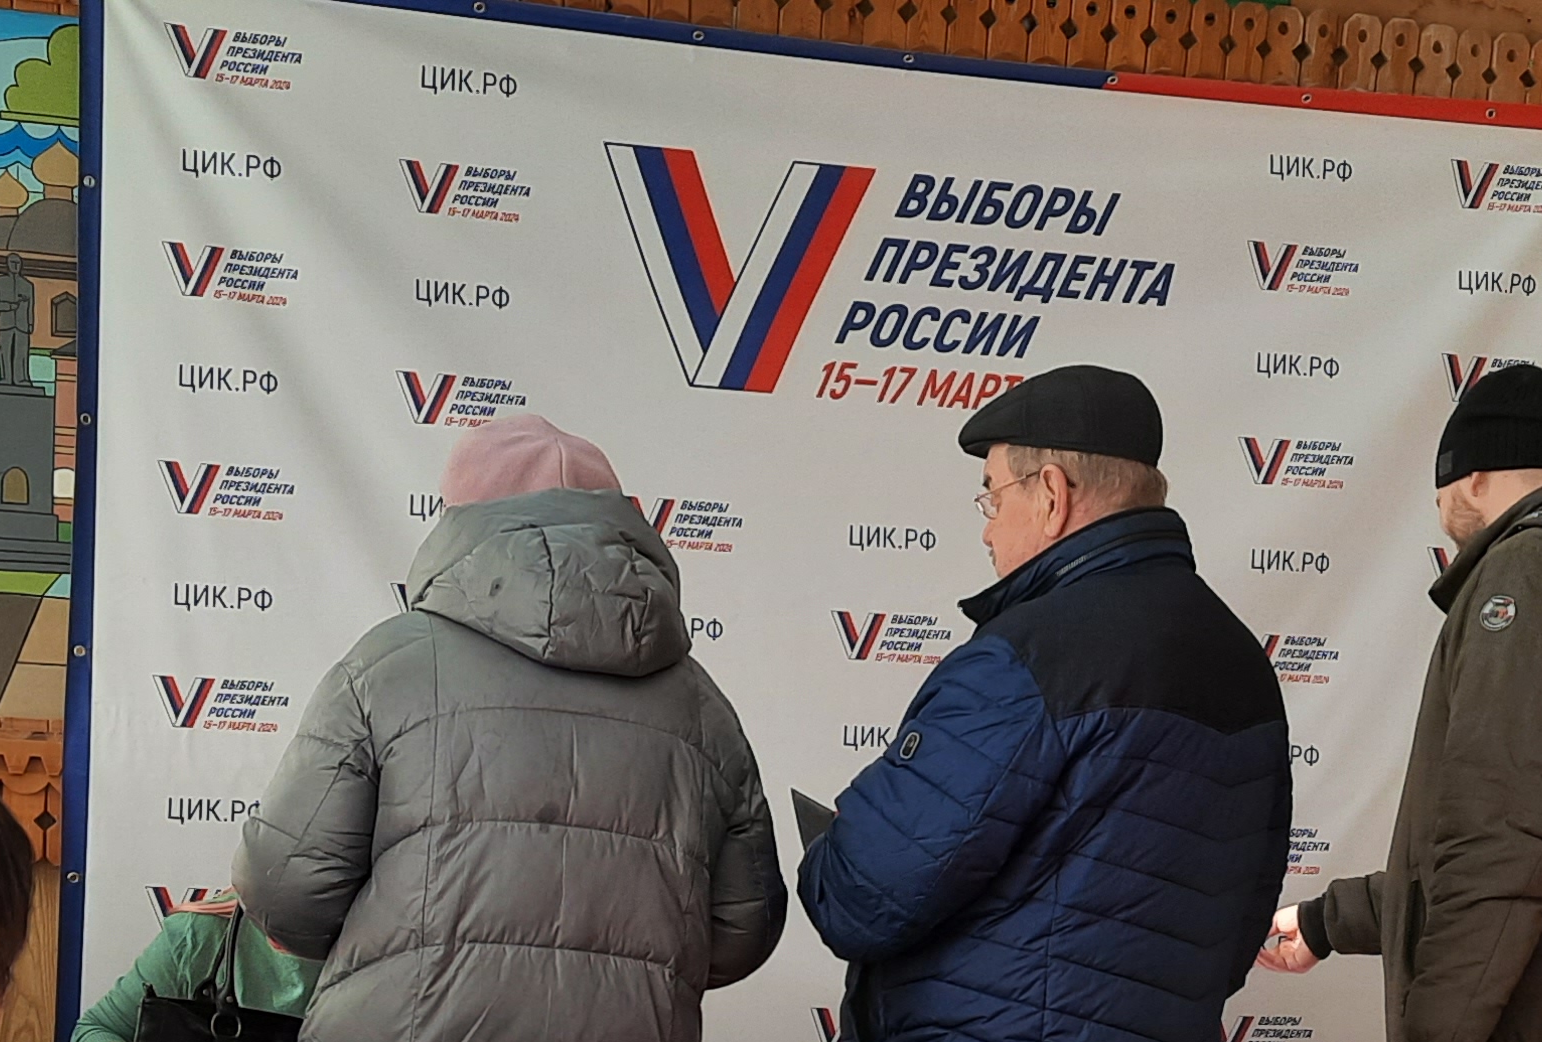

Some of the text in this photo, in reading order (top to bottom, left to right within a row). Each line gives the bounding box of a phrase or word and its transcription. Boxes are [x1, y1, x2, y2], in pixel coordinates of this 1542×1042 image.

[232, 32, 287, 47] ВЫБОРЫ
[227, 46, 302, 64] ПРЕЗИДЕНТА
[220, 60, 269, 75] РОССИИ
[420, 64, 518, 98] ЦИК.РФ
[181, 148, 282, 181] ЦИК.РФ
[1269, 154, 1353, 181] ЦИК.РФ
[464, 166, 517, 180] ВЫБОРЫ
[458, 180, 531, 197] ПРЕЗИДЕНТА
[452, 194, 499, 208] РОССИИ
[894, 174, 1121, 237] ВЫБОРЫ
[230, 249, 283, 264] ВЫБОРЫ
[223, 263, 299, 280] ПРЕЗИДЕНТА
[864, 237, 1175, 307] ПРЕЗИДЕНТА
[217, 276, 266, 291] РОССИИ
[1459, 270, 1536, 297] ЦИК.РФ
[415, 279, 510, 310] ЦИК.РФ
[835, 301, 1041, 359] РОССИИ
[1256, 352, 1340, 378] ЦИК.РФ
[177, 364, 279, 394] ЦИК.РФ
[462, 376, 512, 391] ВЫБОРЫ
[917, 369, 1024, 410] МАР
[456, 390, 526, 406] ПРЕЗИДЕНТА
[449, 404, 496, 416] РОССИИ
[226, 466, 280, 479] ВЫБОРЫ
[219, 480, 295, 494] ПРЕЗИДЕНТА
[213, 494, 262, 506] РОССИИ
[681, 500, 729, 513] ВЫБОРЫ
[675, 514, 743, 528] ПРЕЗИДЕНТА
[669, 527, 713, 538] РОССИИ
[848, 525, 936, 553] ЦИК.РФ
[1250, 548, 1330, 573] ЦИК.РФ
[173, 583, 273, 611] ЦИК.РФ
[891, 614, 937, 625] ВЫБОРЫ
[885, 628, 951, 640] ПРЕЗИДЕНТА
[879, 641, 922, 651] РОССИИ
[221, 680, 274, 692] ВЫБОРЫ
[214, 693, 289, 706] ПРЕЗИДЕНТА
[207, 707, 256, 719] РОССИИ
[843, 725, 891, 751] ЦИК
[1290, 828, 1318, 838] БОРЫ
[1290, 842, 1330, 851] ИДЕНТА
